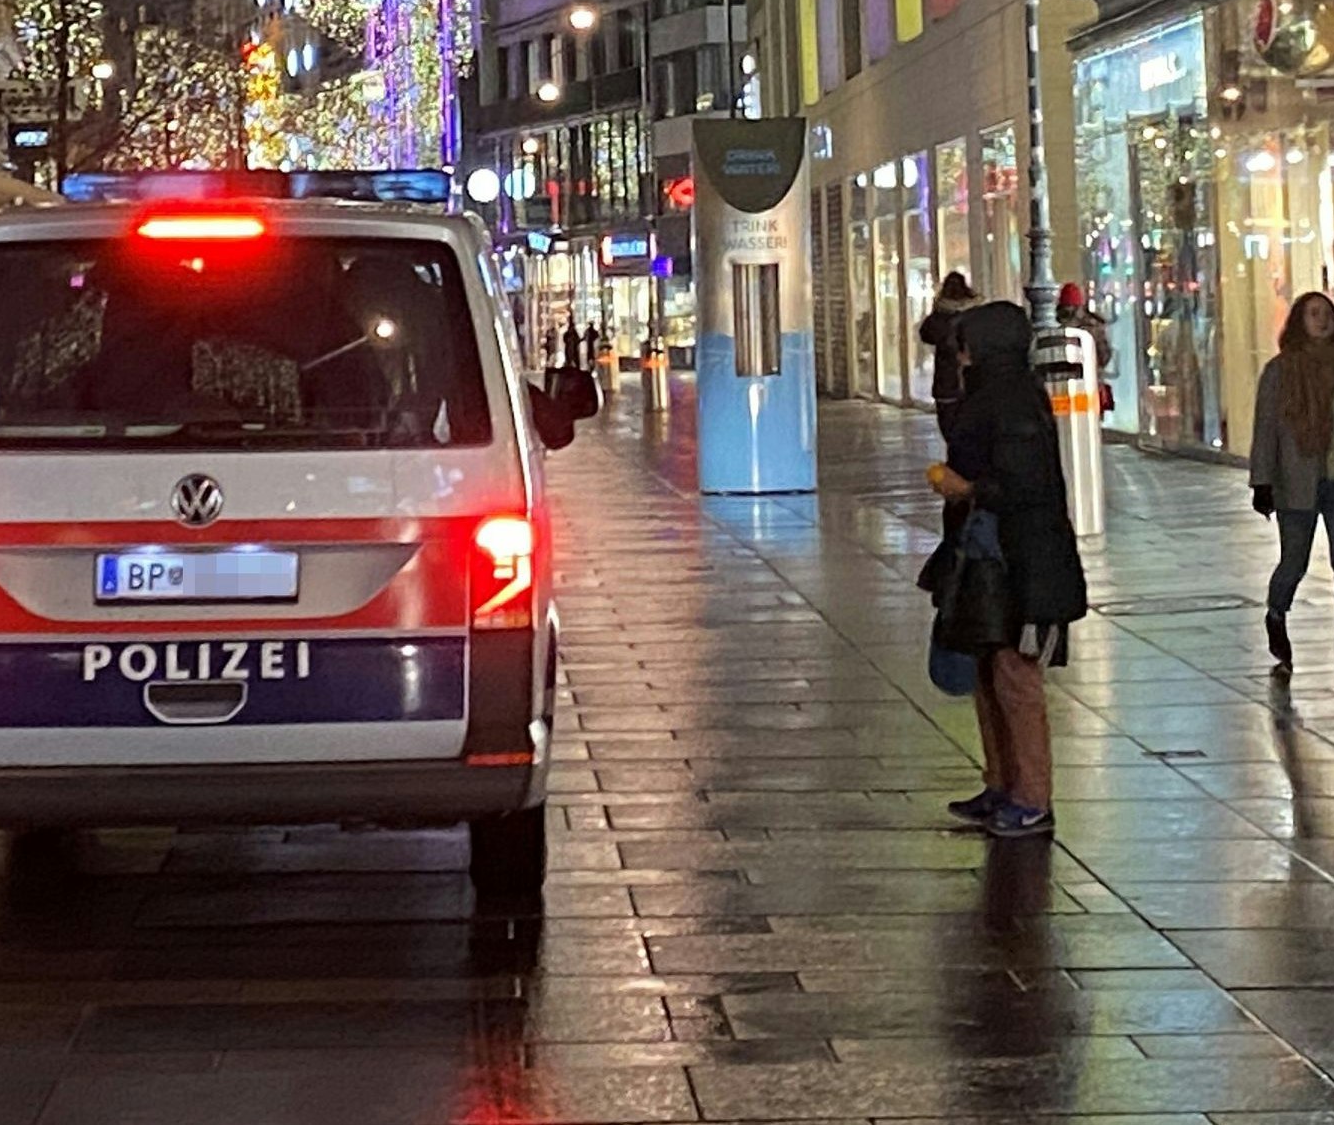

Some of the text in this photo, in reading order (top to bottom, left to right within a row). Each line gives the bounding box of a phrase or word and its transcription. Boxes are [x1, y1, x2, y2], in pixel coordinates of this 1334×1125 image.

[732, 219, 779, 233] TRINK
[128, 563, 165, 590] BP
[83, 640, 310, 681] POLIZEI
